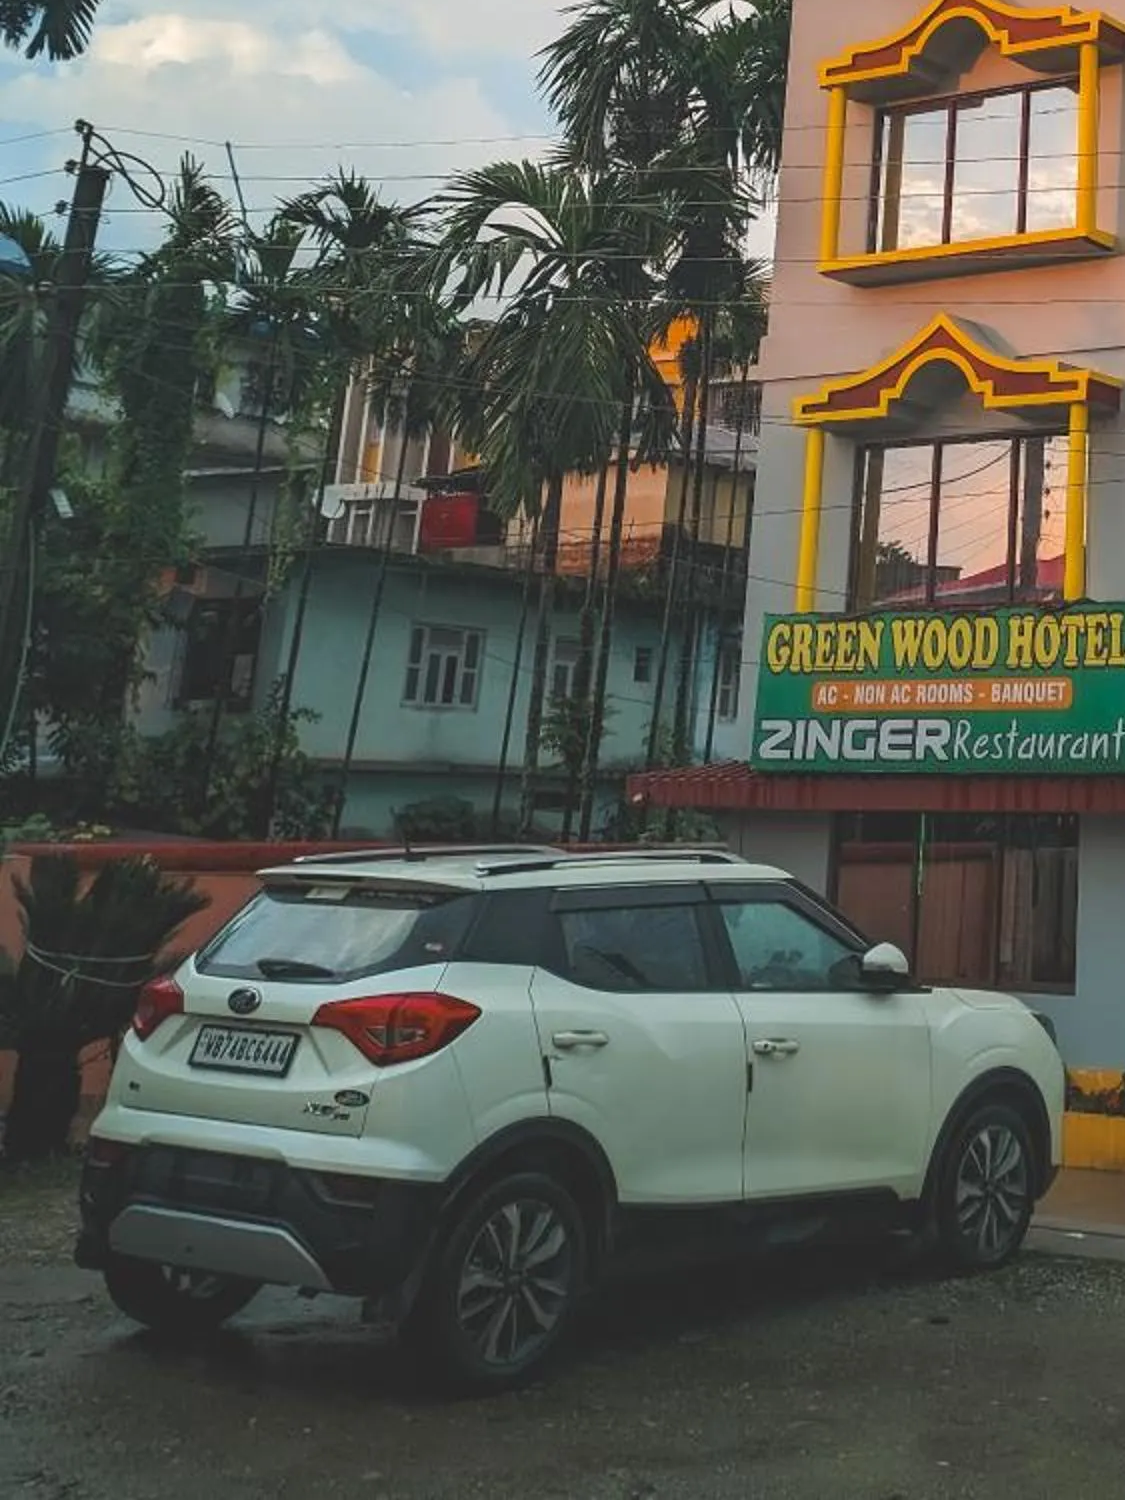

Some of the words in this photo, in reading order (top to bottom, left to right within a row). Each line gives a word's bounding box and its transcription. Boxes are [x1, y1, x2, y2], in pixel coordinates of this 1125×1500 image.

[767, 619, 884, 673] GREEN
[891, 616, 1000, 671] WOOD
[817, 686, 837, 705] AC
[853, 684, 885, 704] NON
[890, 684, 911, 703] AC
[915, 682, 973, 703] ROOMS
[991, 681, 1067, 702] BANQUET
[758, 719, 950, 761] ZINGER
[953, 717, 1125, 761] Restaurant
